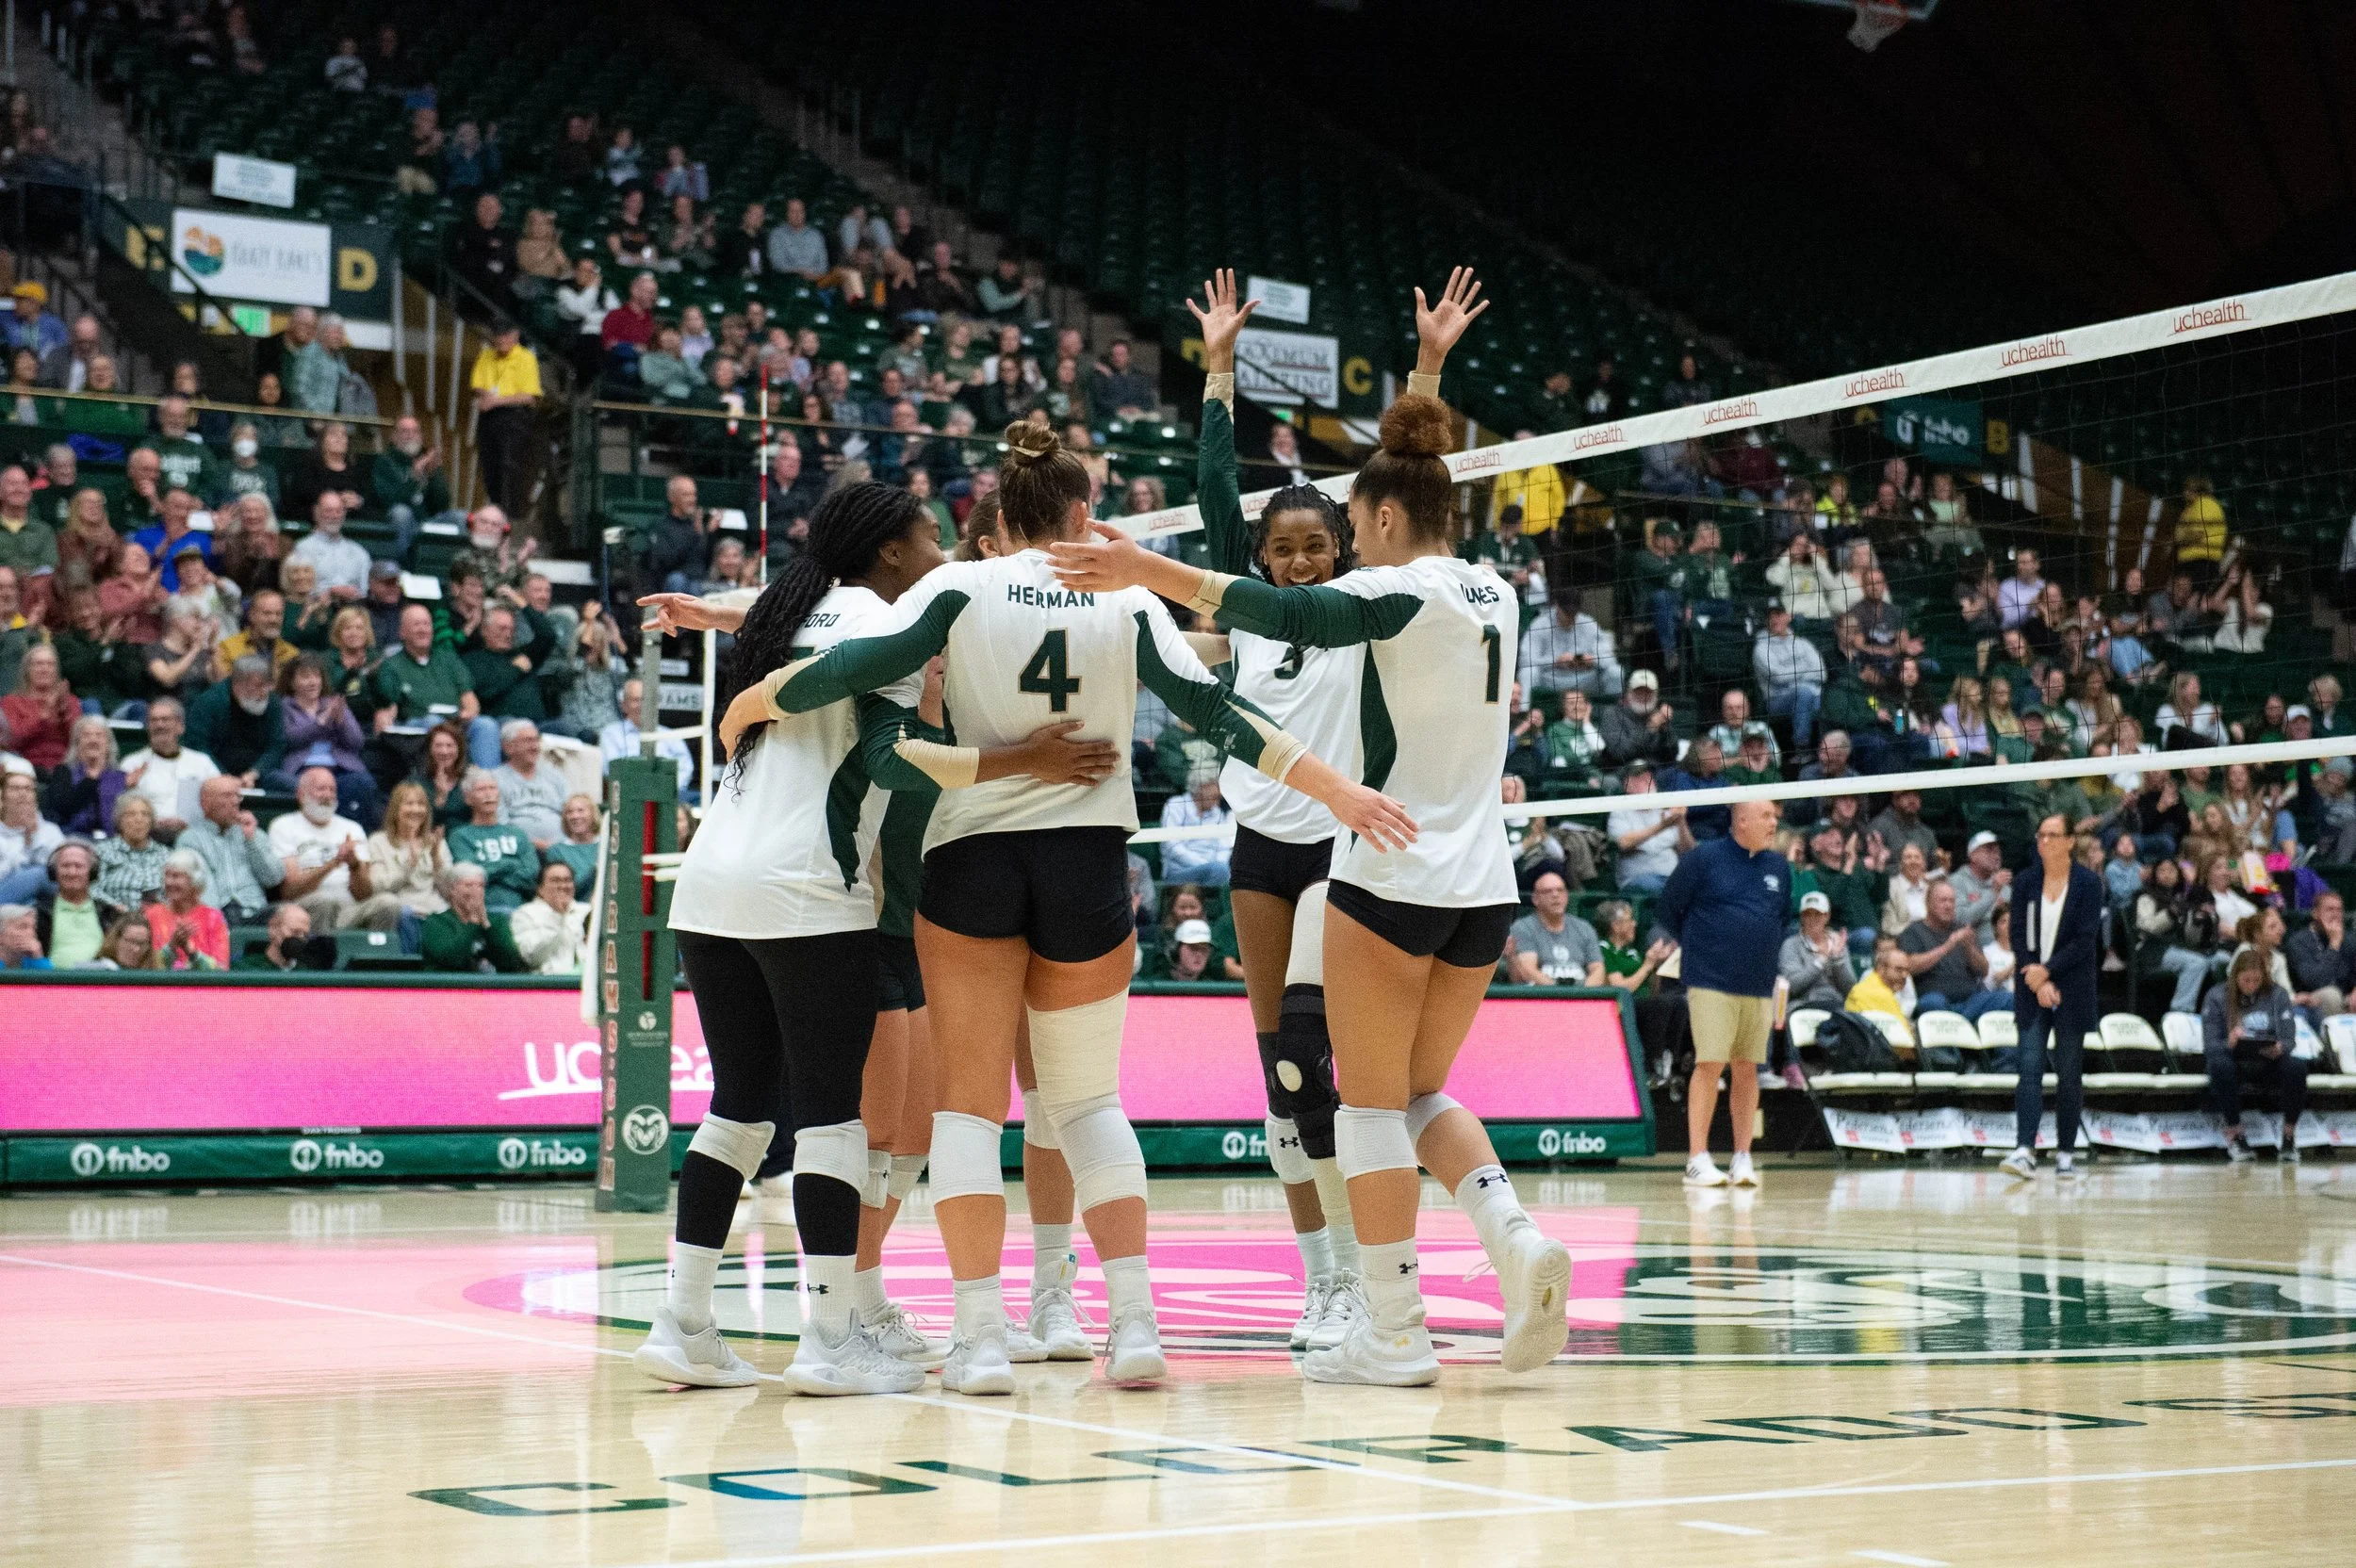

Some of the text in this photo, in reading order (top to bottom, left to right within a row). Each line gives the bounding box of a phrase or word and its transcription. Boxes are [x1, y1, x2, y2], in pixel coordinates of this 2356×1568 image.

[337, 247, 378, 293] D
[2171, 298, 2246, 333] uchealth
[2001, 334, 2067, 368] uchealth
[1342, 355, 1373, 397] C
[1844, 367, 1906, 399] uchealth
[1703, 396, 1759, 426] uchealth
[1573, 423, 1624, 451] uchealth
[1455, 447, 1504, 473] uchealth
[1007, 583, 1095, 609] HERMAN
[1018, 627, 1083, 714] 4
[1480, 623, 1501, 705] 1
[324, 1141, 385, 1169] fnbo
[530, 1139, 587, 1167] fnbo
[1249, 1134, 1269, 1158] fn
[1561, 1131, 1607, 1153] fnbo
[106, 1145, 172, 1173] fnbo
[406, 1406, 2148, 1517] COLORADO
